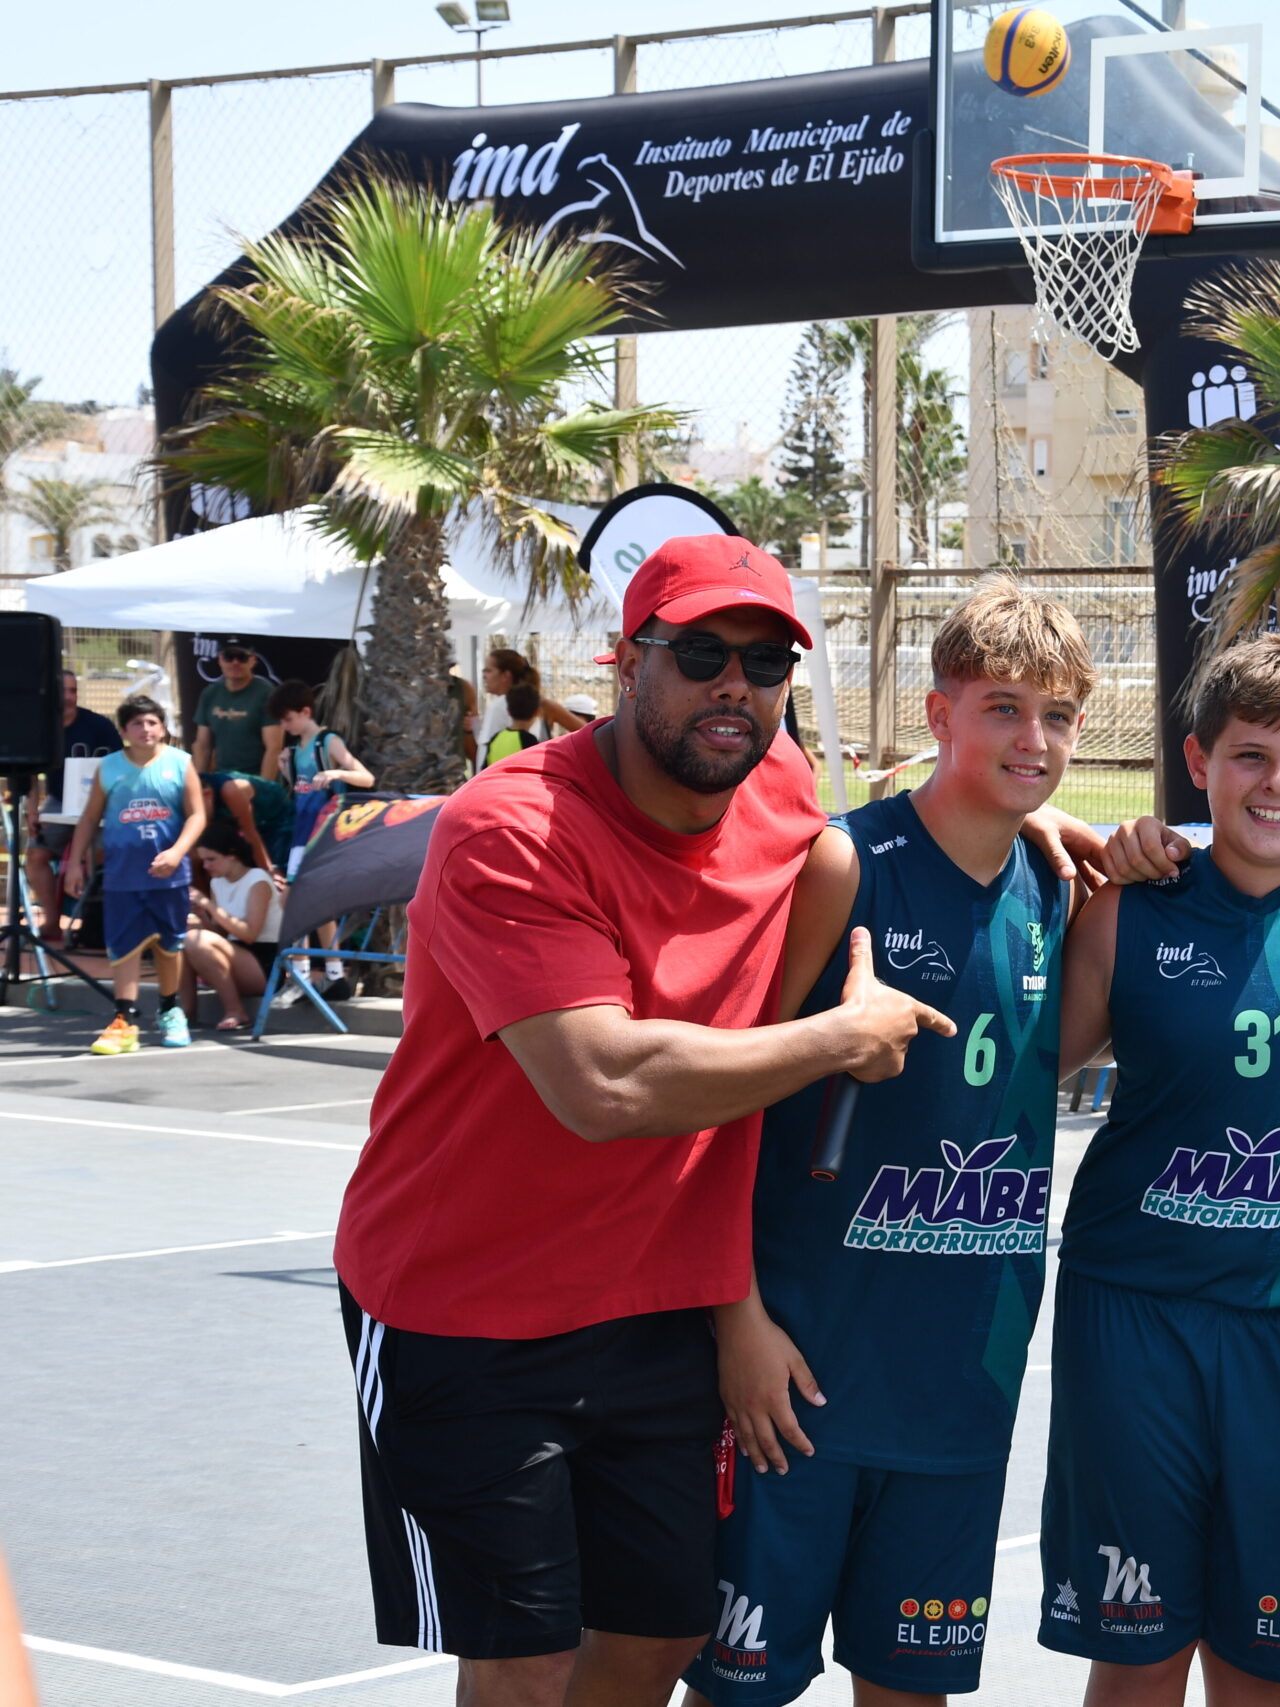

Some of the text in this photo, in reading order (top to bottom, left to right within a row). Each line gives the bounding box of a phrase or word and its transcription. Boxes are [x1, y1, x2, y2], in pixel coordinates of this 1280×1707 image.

[633, 110, 912, 167] Instituto Municipal de
[449, 122, 581, 201] imd
[664, 148, 904, 202] Deportes de El Ejido
[193, 632, 219, 656] im
[130, 800, 159, 809] COPA
[137, 823, 158, 840] 15
[885, 927, 923, 951] imd
[1156, 942, 1195, 961] imd
[921, 972, 951, 982] El Ejido
[1200, 979, 1222, 988] Ejido
[963, 1013, 996, 1087] 6
[856, 1165, 1051, 1226] MABE
[844, 1226, 1045, 1254] HORTOFRUTICOLA
[1051, 1607, 1081, 1625] luanvi
[1100, 1604, 1163, 1620] MERCADER
[897, 1622, 985, 1645] EL EJIDO
[1100, 1618, 1164, 1634] Consultores
[1257, 1618, 1280, 1638] EL
[711, 1658, 766, 1681] Consultores
